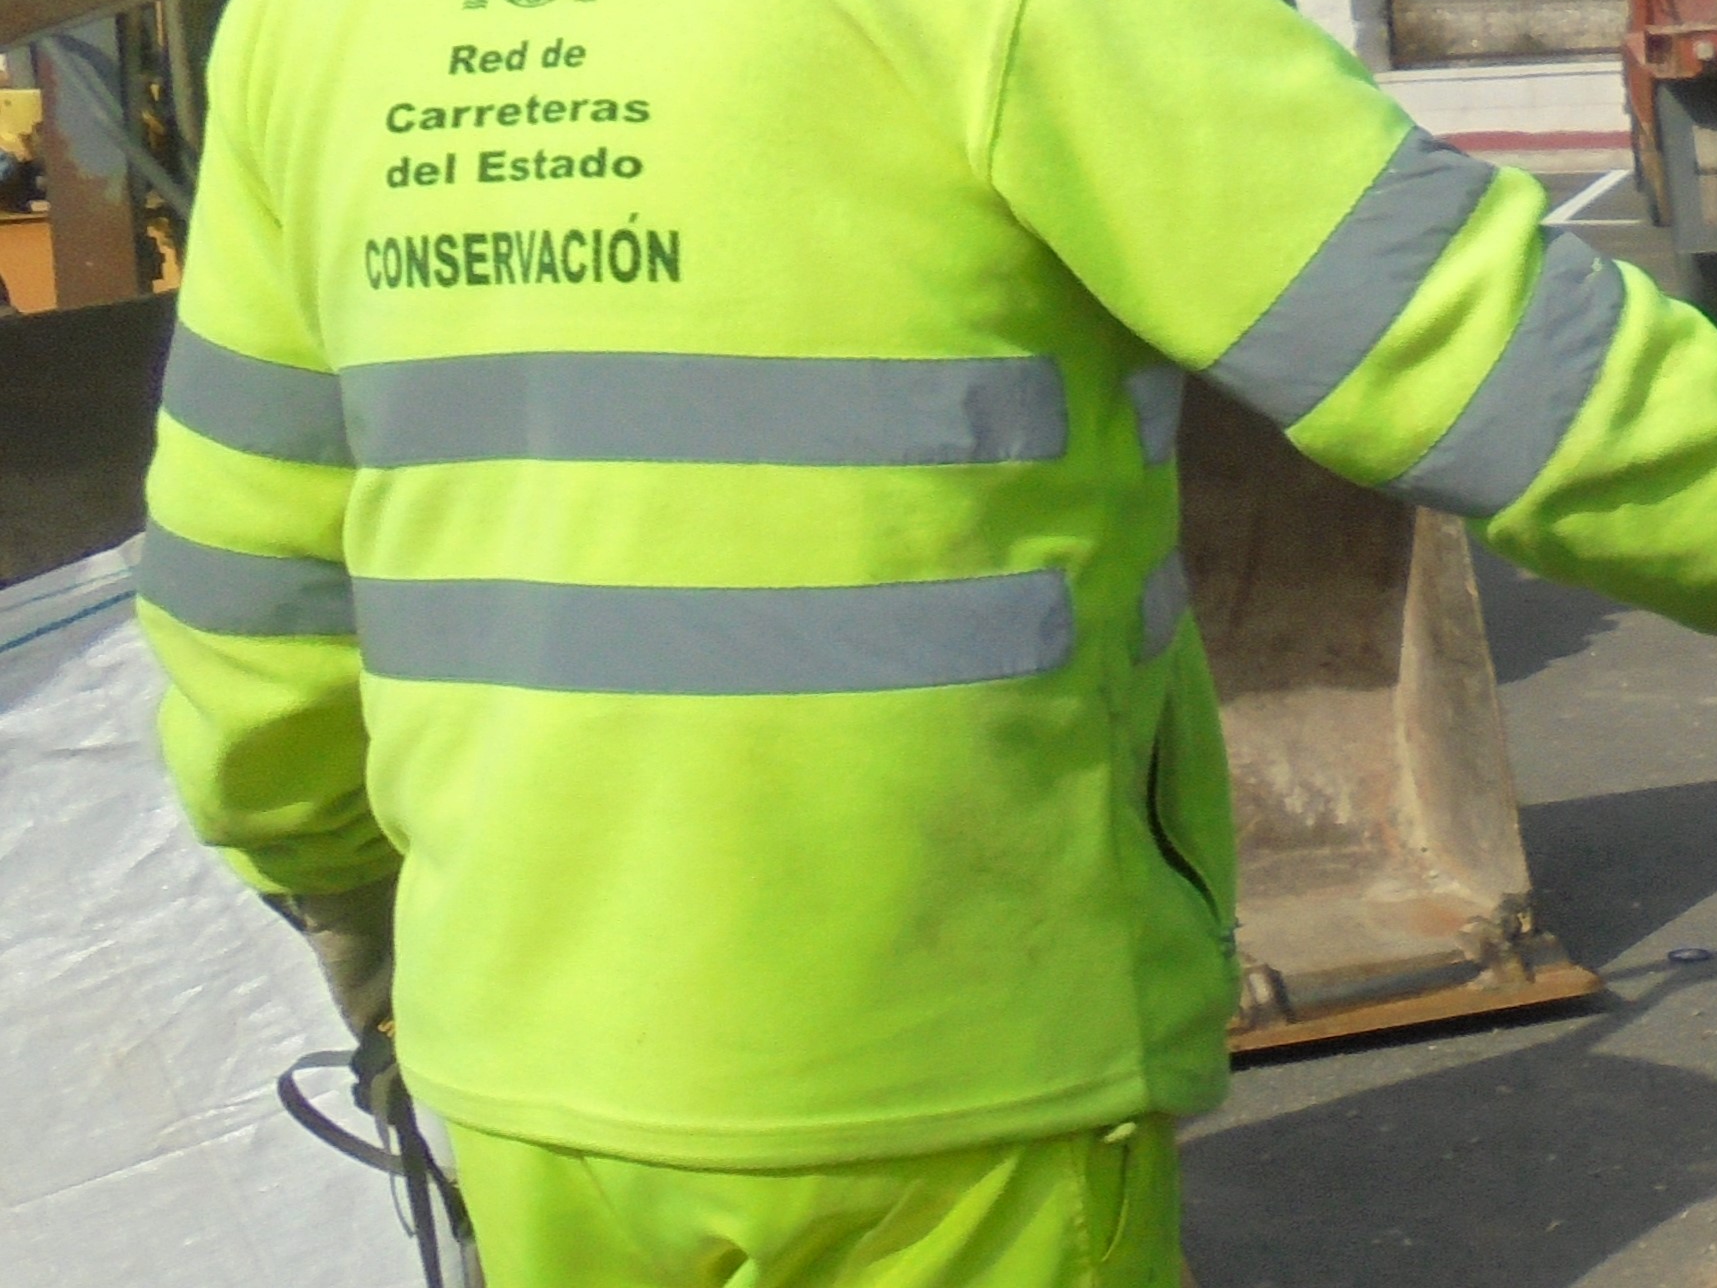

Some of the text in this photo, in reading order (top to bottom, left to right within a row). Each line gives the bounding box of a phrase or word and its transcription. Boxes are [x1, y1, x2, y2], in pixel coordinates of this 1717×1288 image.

[448, 37, 588, 75] Red de
[385, 93, 652, 134] Carreteras
[385, 146, 645, 189] del Estado
[365, 212, 682, 290] CONSERVACIÓN
